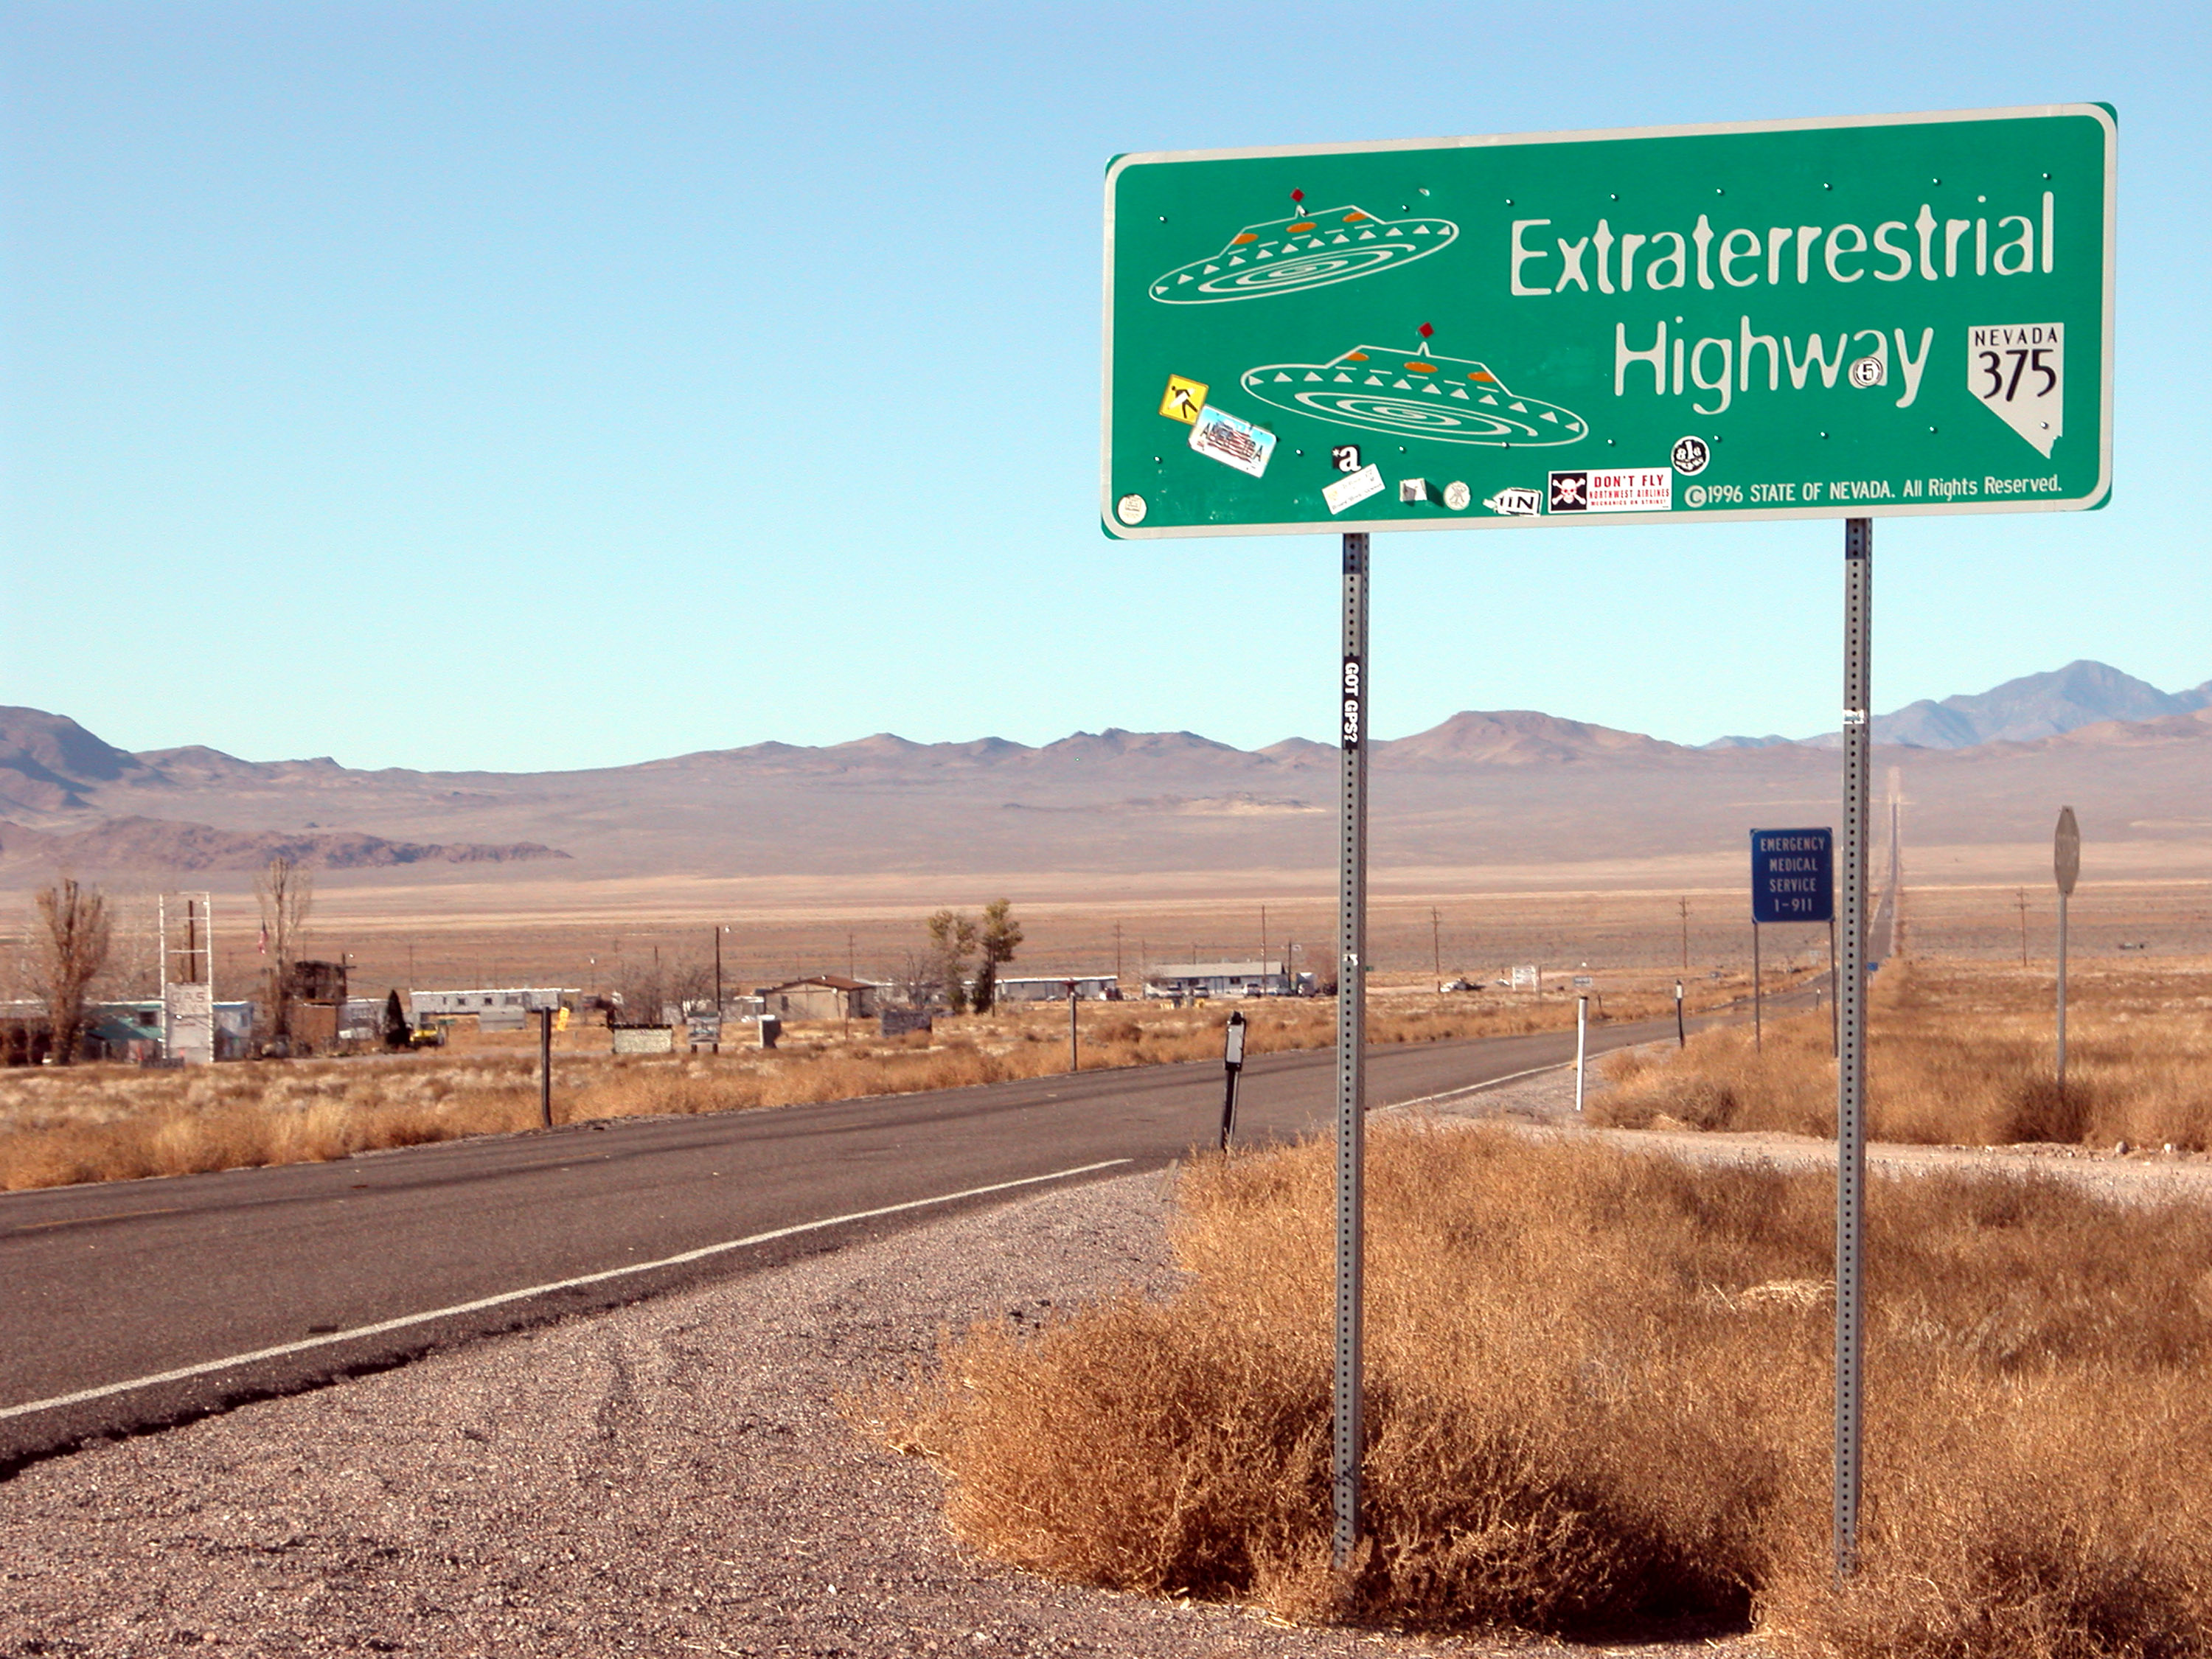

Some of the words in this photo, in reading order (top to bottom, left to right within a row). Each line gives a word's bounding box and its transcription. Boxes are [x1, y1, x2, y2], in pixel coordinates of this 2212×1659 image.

[1510, 190, 2054, 296] Extraterrestrial
[1975, 327, 2058, 347] NEVADA
[1614, 315, 1934, 415] Highway
[1978, 349, 2056, 402] 375
[1594, 476, 1635, 487] DON'T
[1642, 474, 1663, 486] FLY
[1750, 483, 1796, 502] STATE
[1802, 482, 1823, 501] OF
[1829, 480, 1896, 500] NEVADA.
[1902, 479, 1923, 498] All
[1928, 478, 1978, 501] Rights
[1984, 473, 2063, 495] Reserved.
[1589, 490, 1633, 499] NORTHWEST
[1637, 488, 1669, 498] AIRLINES
[1345, 662, 1359, 697] GOT
[1344, 700, 1358, 742] GPS?
[1760, 837, 1825, 852] EMERGENCY
[1770, 858, 1818, 872] MEDICAL
[1770, 878, 1817, 892] SERVICE
[1774, 898, 1812, 911] 1-911
